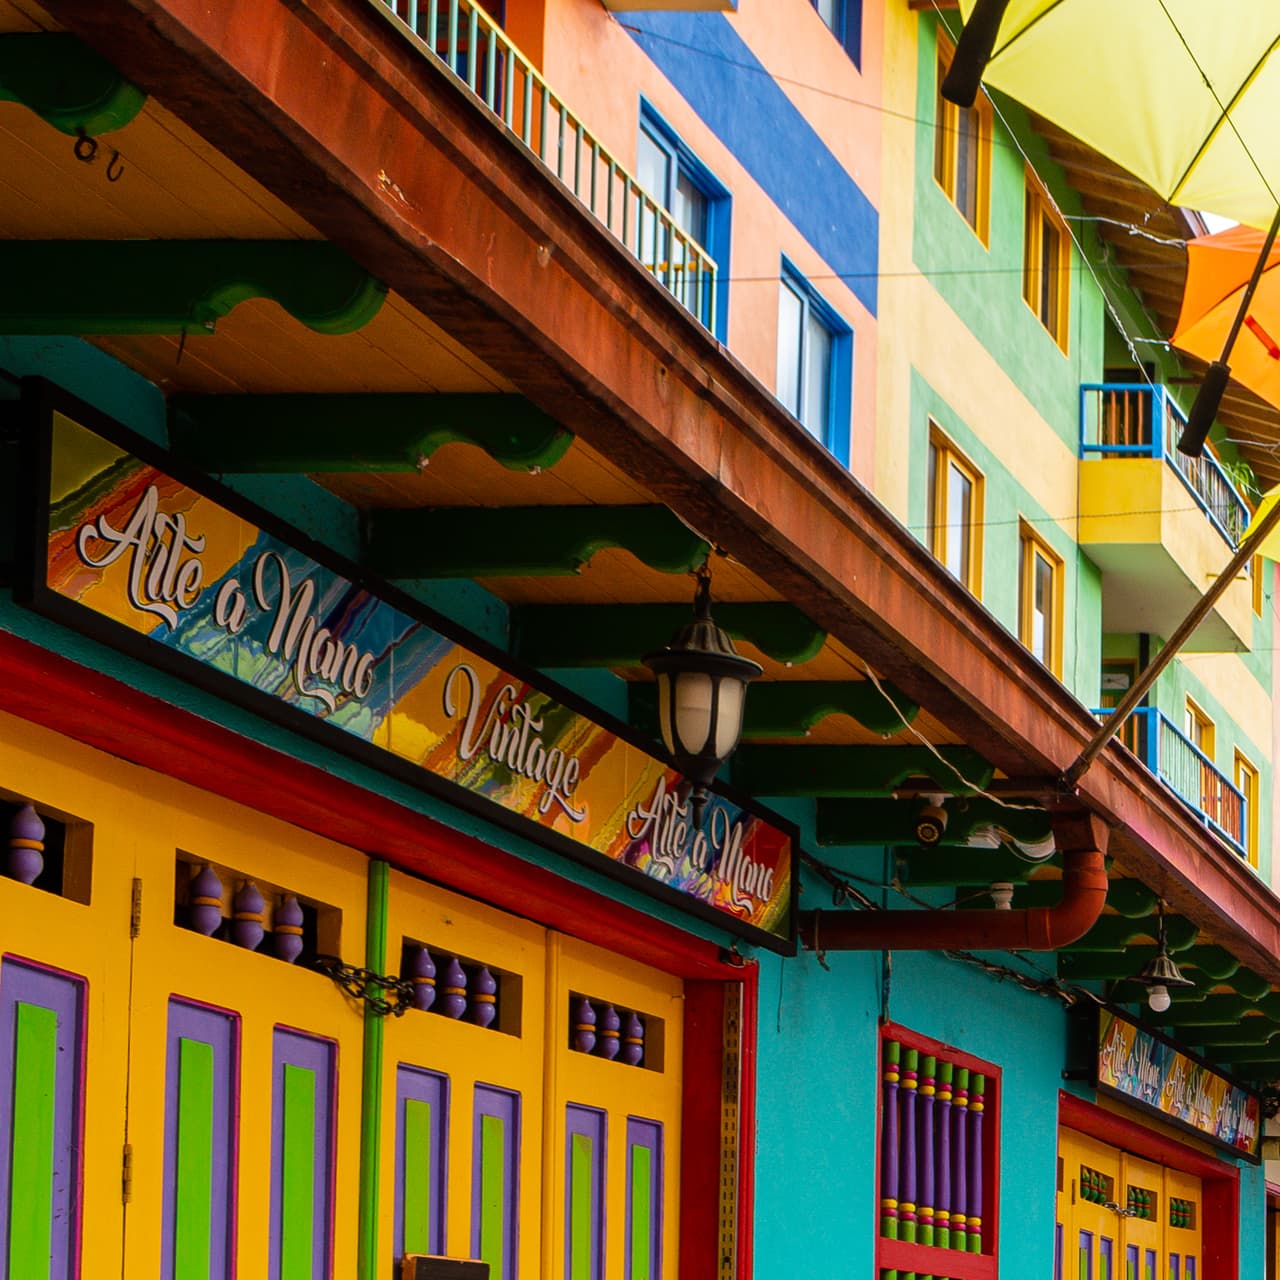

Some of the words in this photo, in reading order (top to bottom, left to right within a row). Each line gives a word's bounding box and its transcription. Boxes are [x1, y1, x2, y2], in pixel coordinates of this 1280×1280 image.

[77, 485, 206, 634] Arte
[213, 578, 246, 634] a
[253, 551, 376, 714] Mano
[443, 663, 588, 824] Vintage
[627, 776, 690, 877] Arte
[693, 832, 707, 868] a
[711, 807, 774, 915] Mano
